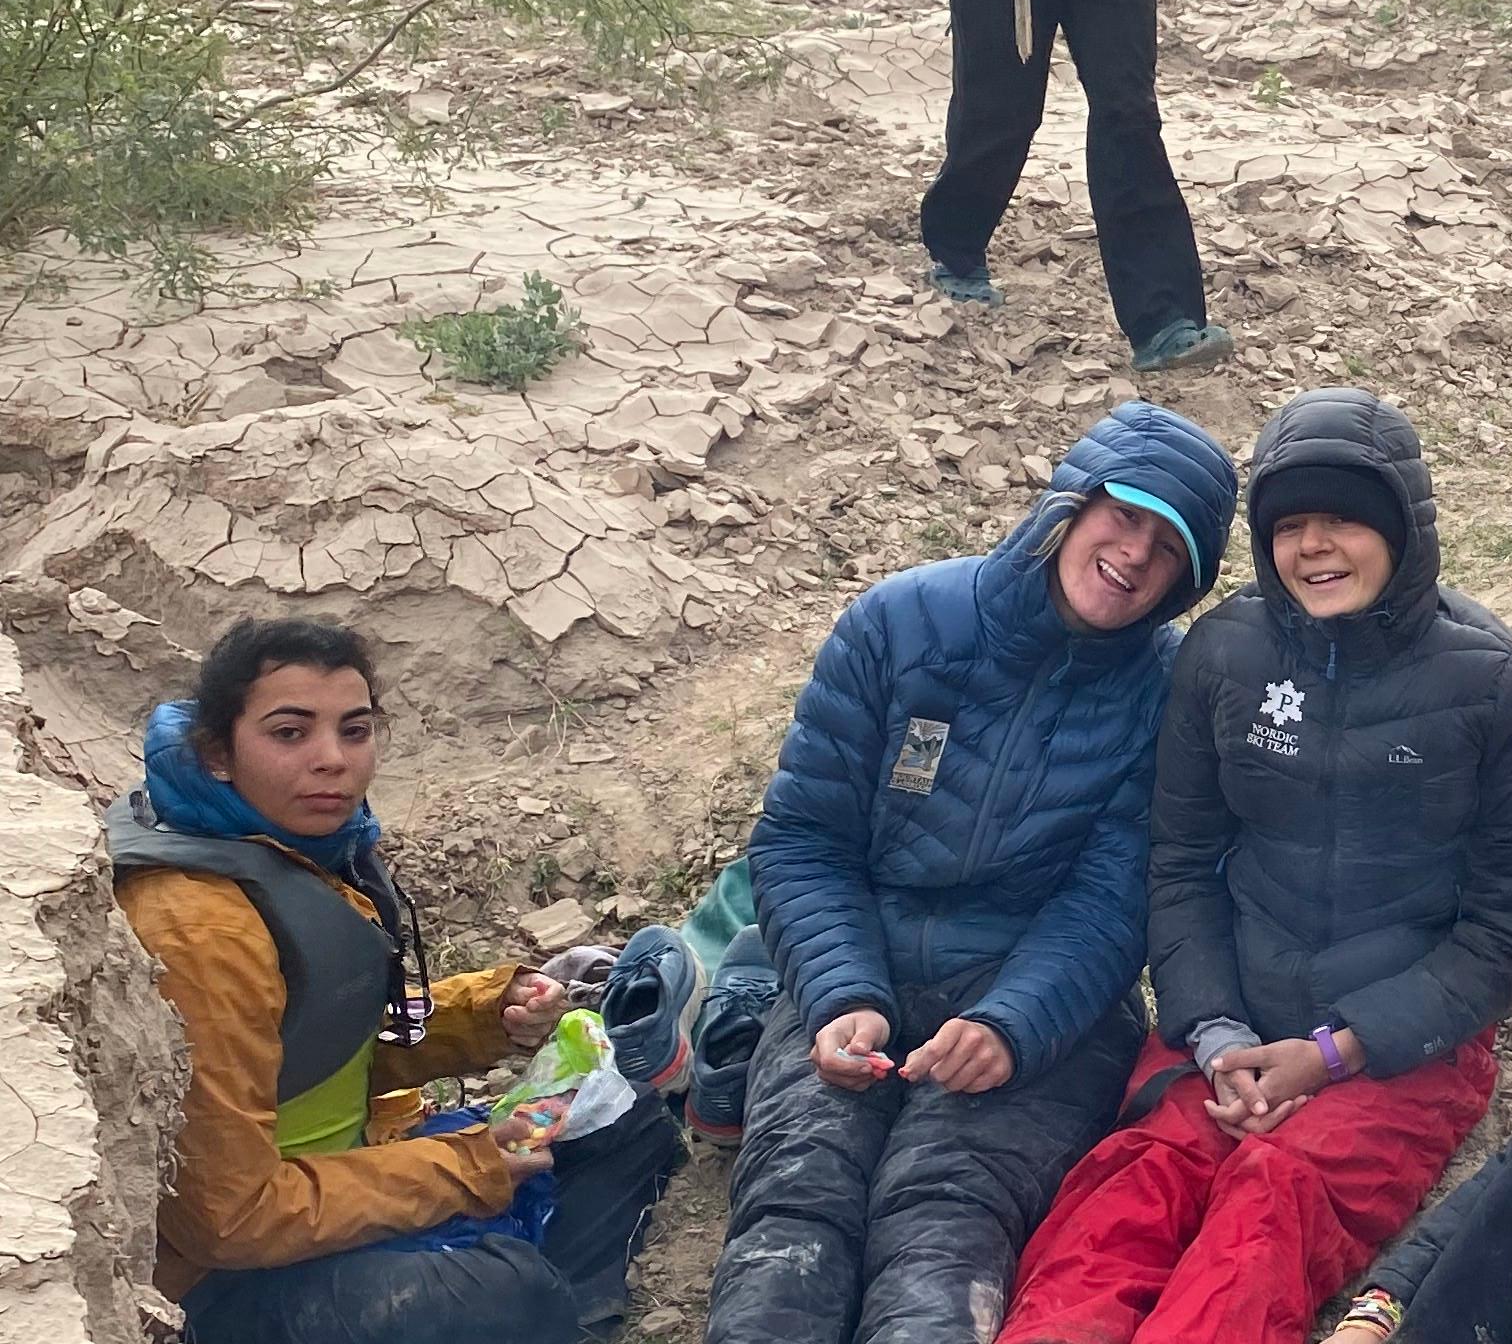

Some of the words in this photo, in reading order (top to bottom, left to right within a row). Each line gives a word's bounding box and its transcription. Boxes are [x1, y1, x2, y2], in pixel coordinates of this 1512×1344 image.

[1278, 692, 1293, 712] P
[1247, 733, 1265, 748] SKI
[1267, 739, 1300, 756] TEAM
[1252, 722, 1299, 745] NORDIC
